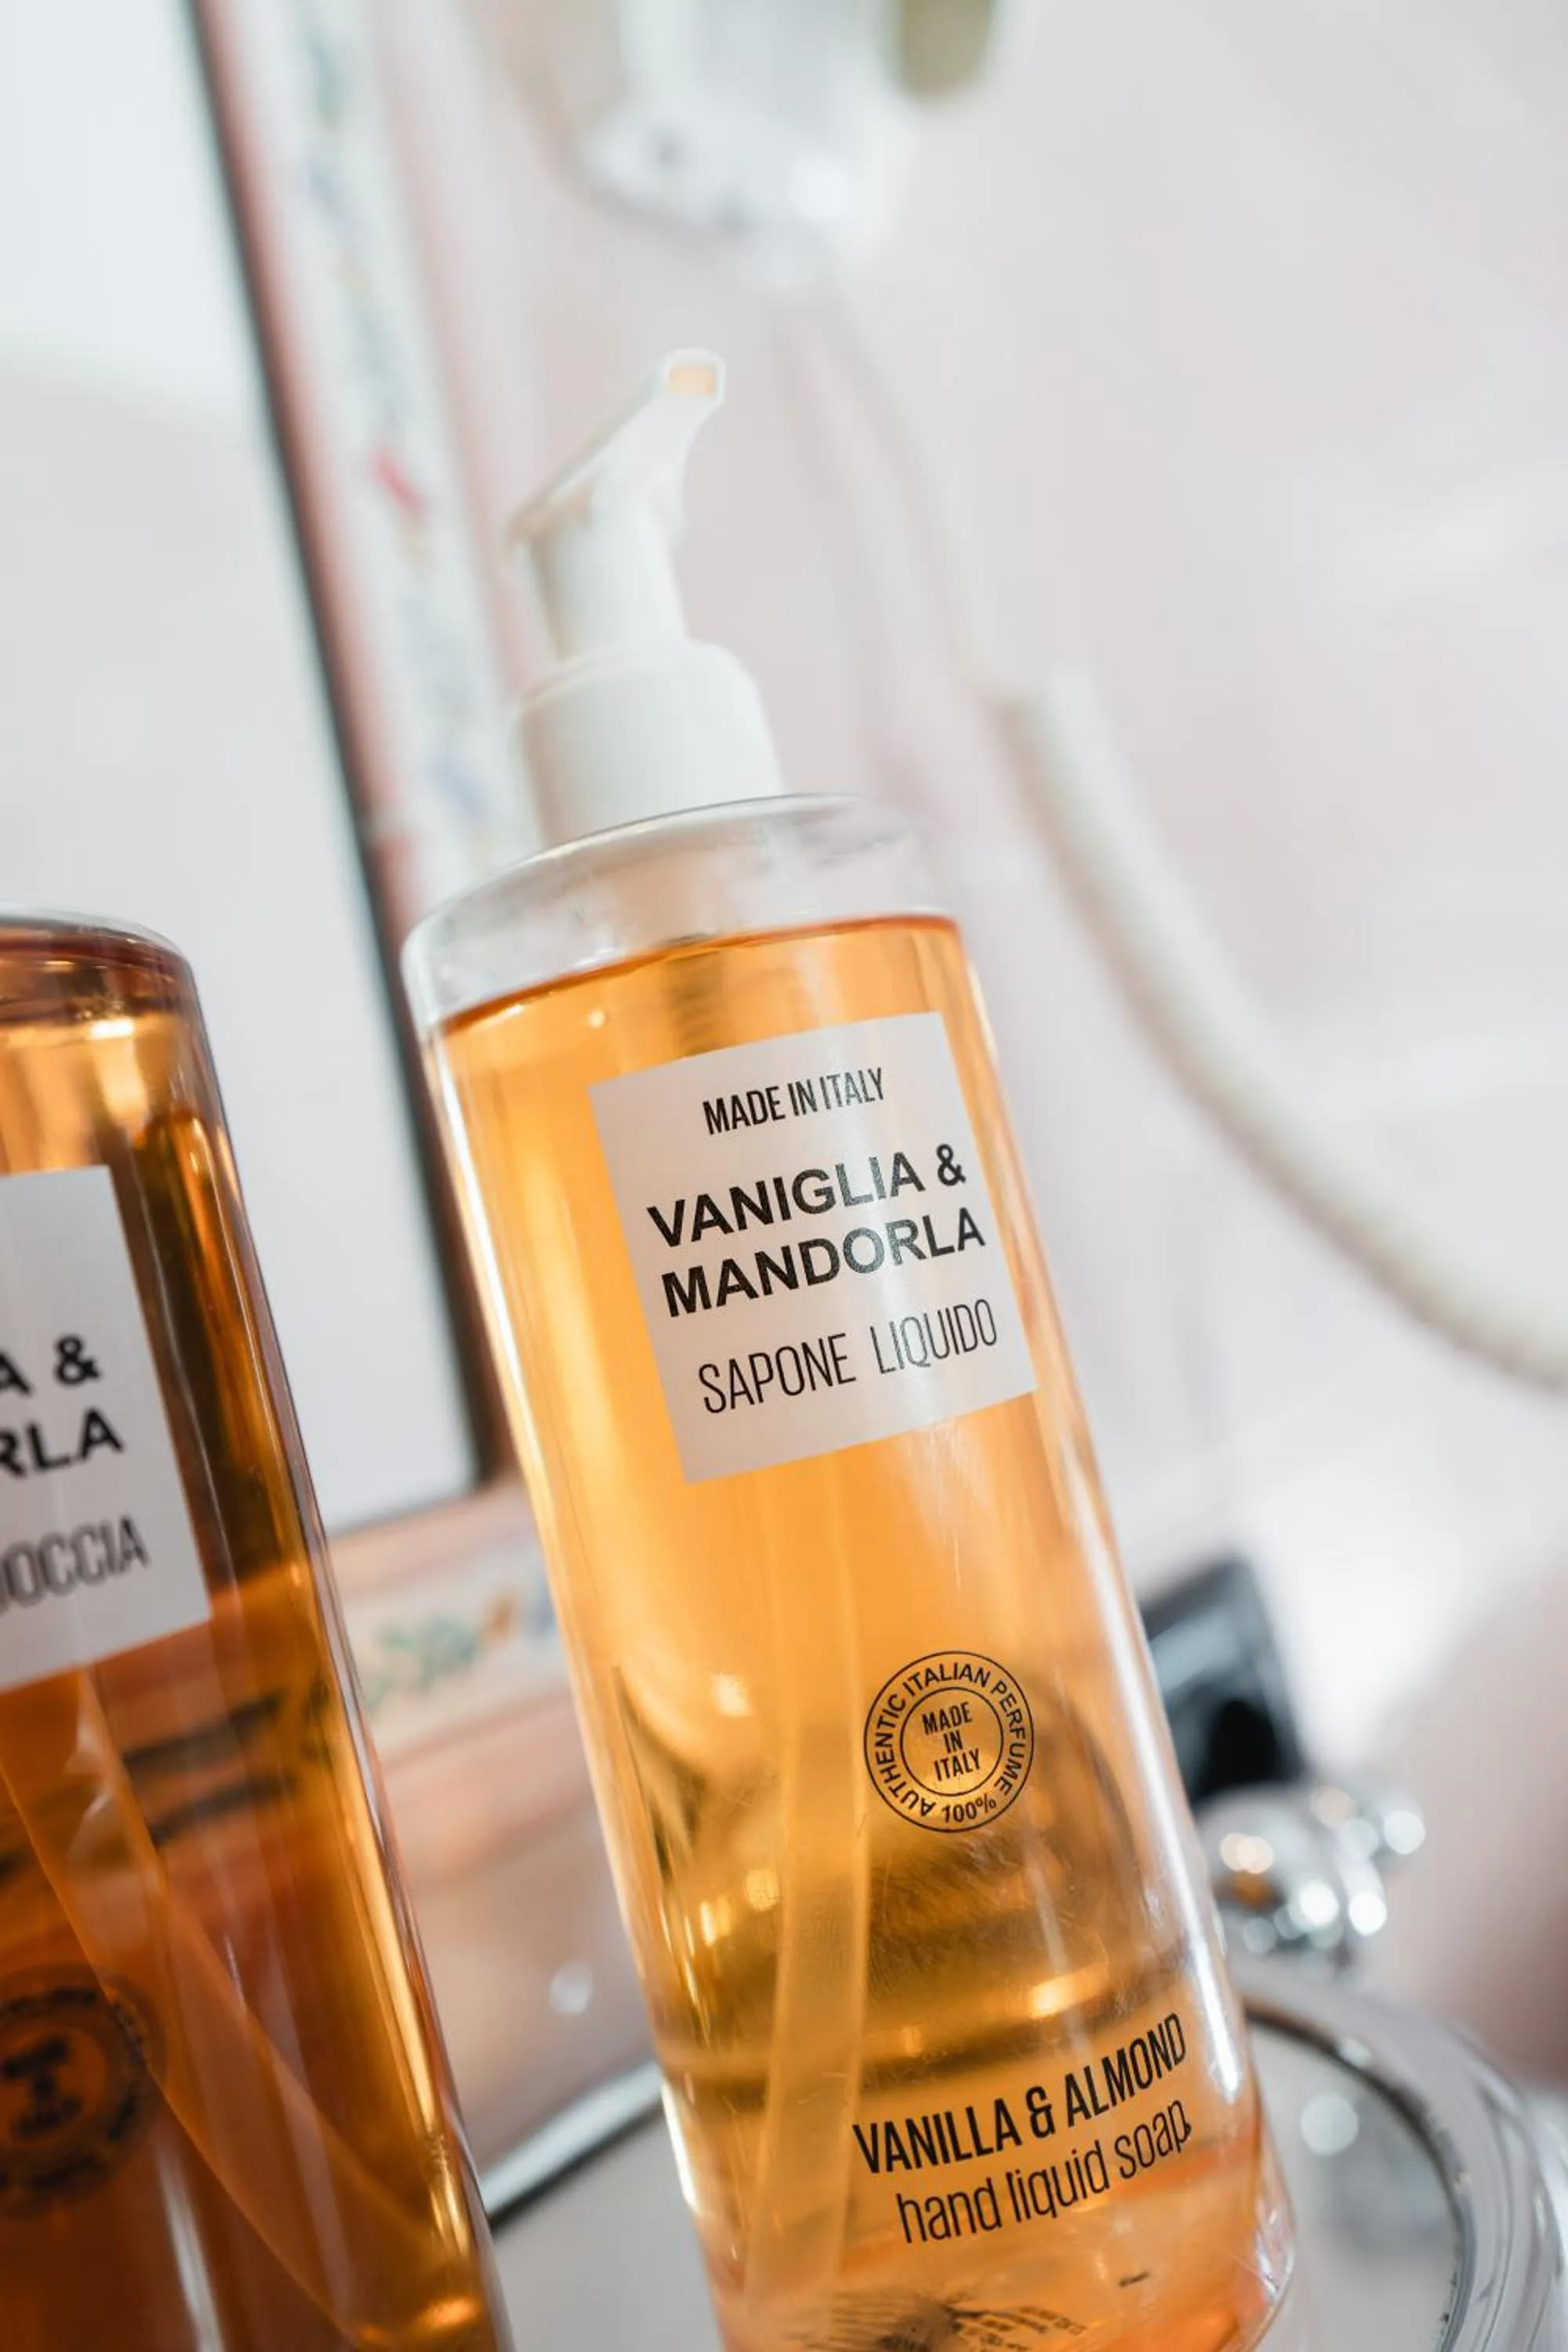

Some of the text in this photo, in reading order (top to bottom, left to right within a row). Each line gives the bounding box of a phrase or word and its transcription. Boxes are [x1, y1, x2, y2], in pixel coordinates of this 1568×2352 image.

[702, 1067, 885, 1135] MADE IN ITALY
[647, 1144, 966, 1247] VANIGLIA &
[662, 1207, 985, 1317] MANDORLA
[54, 1335, 100, 1387] &
[699, 1298, 998, 1414] SAPONE LIQUIDO
[874, 1662, 1027, 1824] 100% AUTHENTIC ITALIAN PERFUME
[922, 1701, 973, 1736] MADE
[934, 1748, 981, 1782] ITALY
[943, 1729, 964, 1754] IN
[852, 2013, 1187, 2175] VANILLA & ALMOND
[896, 2100, 1192, 2244] hand liquid soap
